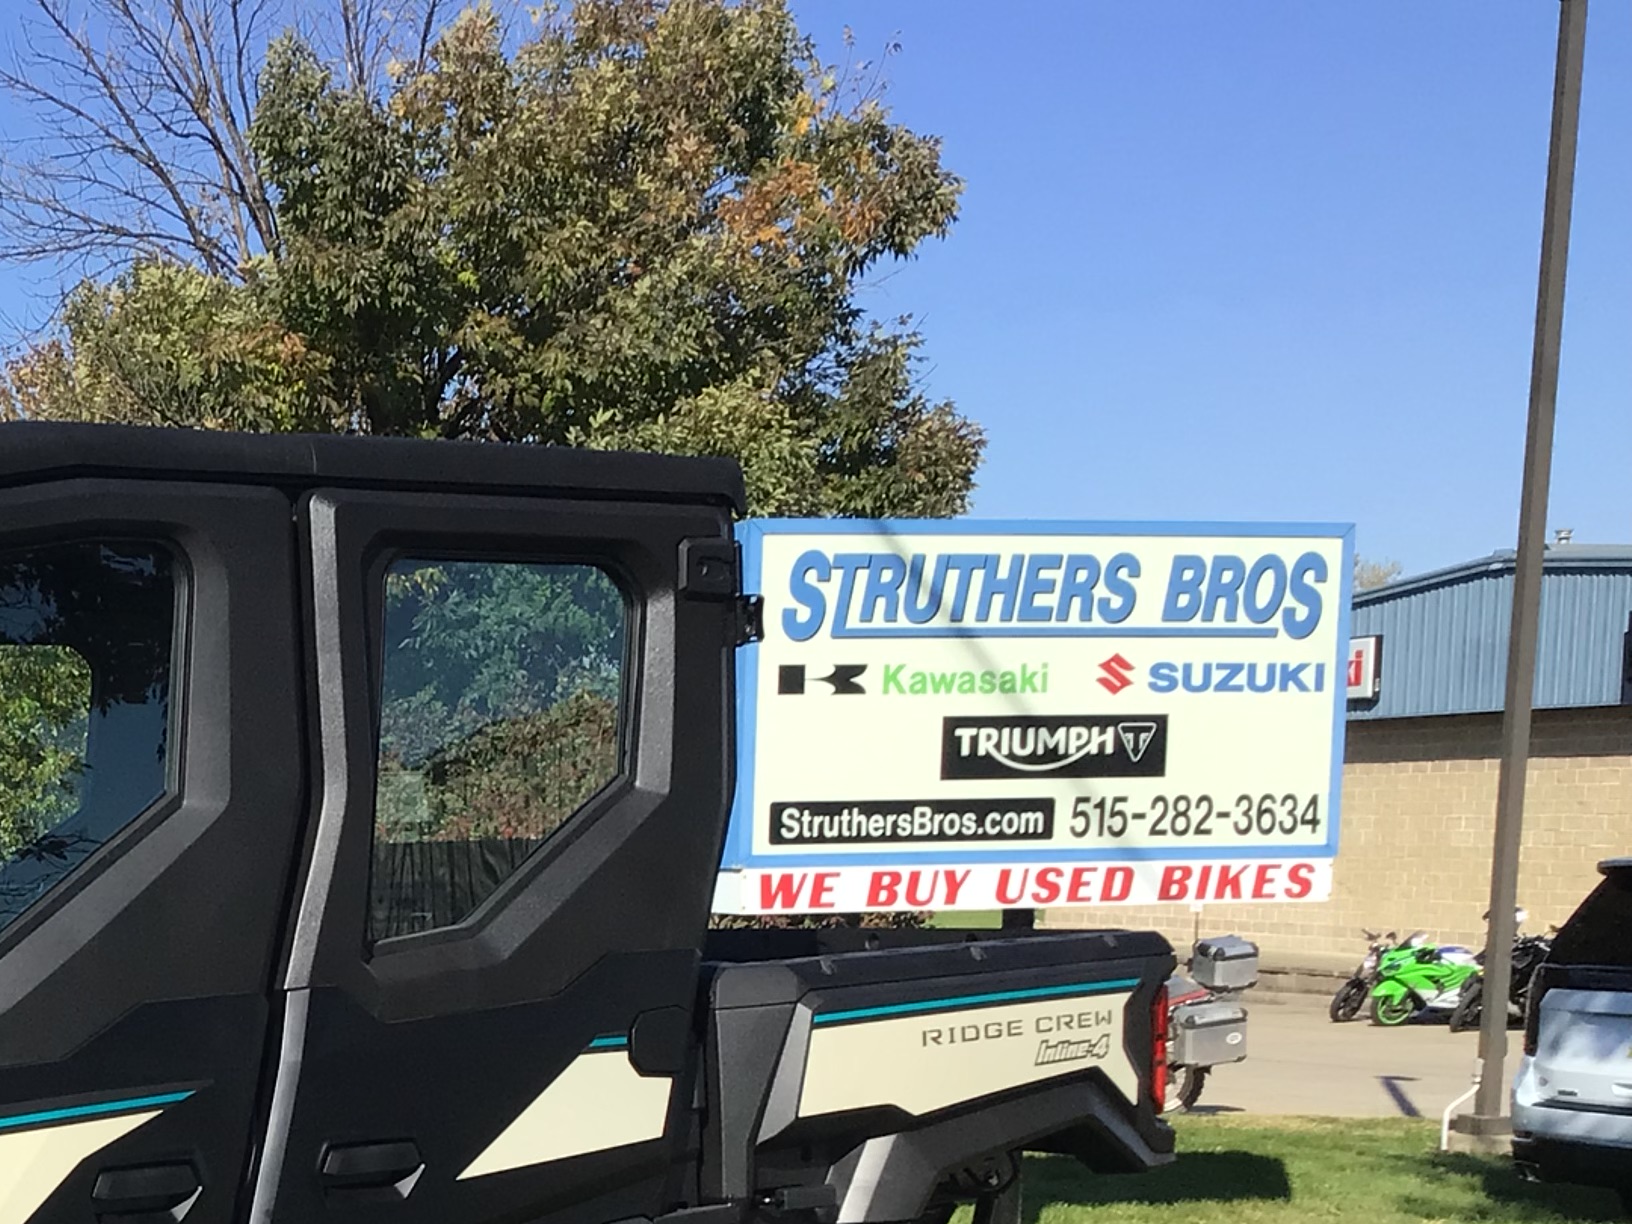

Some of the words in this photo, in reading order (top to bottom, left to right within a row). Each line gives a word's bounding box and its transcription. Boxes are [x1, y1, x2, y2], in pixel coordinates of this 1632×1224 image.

[781, 550, 1141, 641] STRUTHERS
[1160, 551, 1328, 640] BROS
[882, 664, 1048, 695] Kawasaki
[1148, 662, 1324, 693] SUZUKI
[954, 726, 1115, 771] TRIUMPH
[780, 806, 1045, 839] StruthersBros.com
[1070, 795, 1321, 838] 515-282-3634
[759, 872, 838, 910] WE
[866, 869, 971, 908] BUY
[994, 866, 1135, 905] USED
[1157, 862, 1316, 901] BIKES
[922, 1019, 1024, 1048] RIDGE
[1035, 1010, 1113, 1034] CREW
